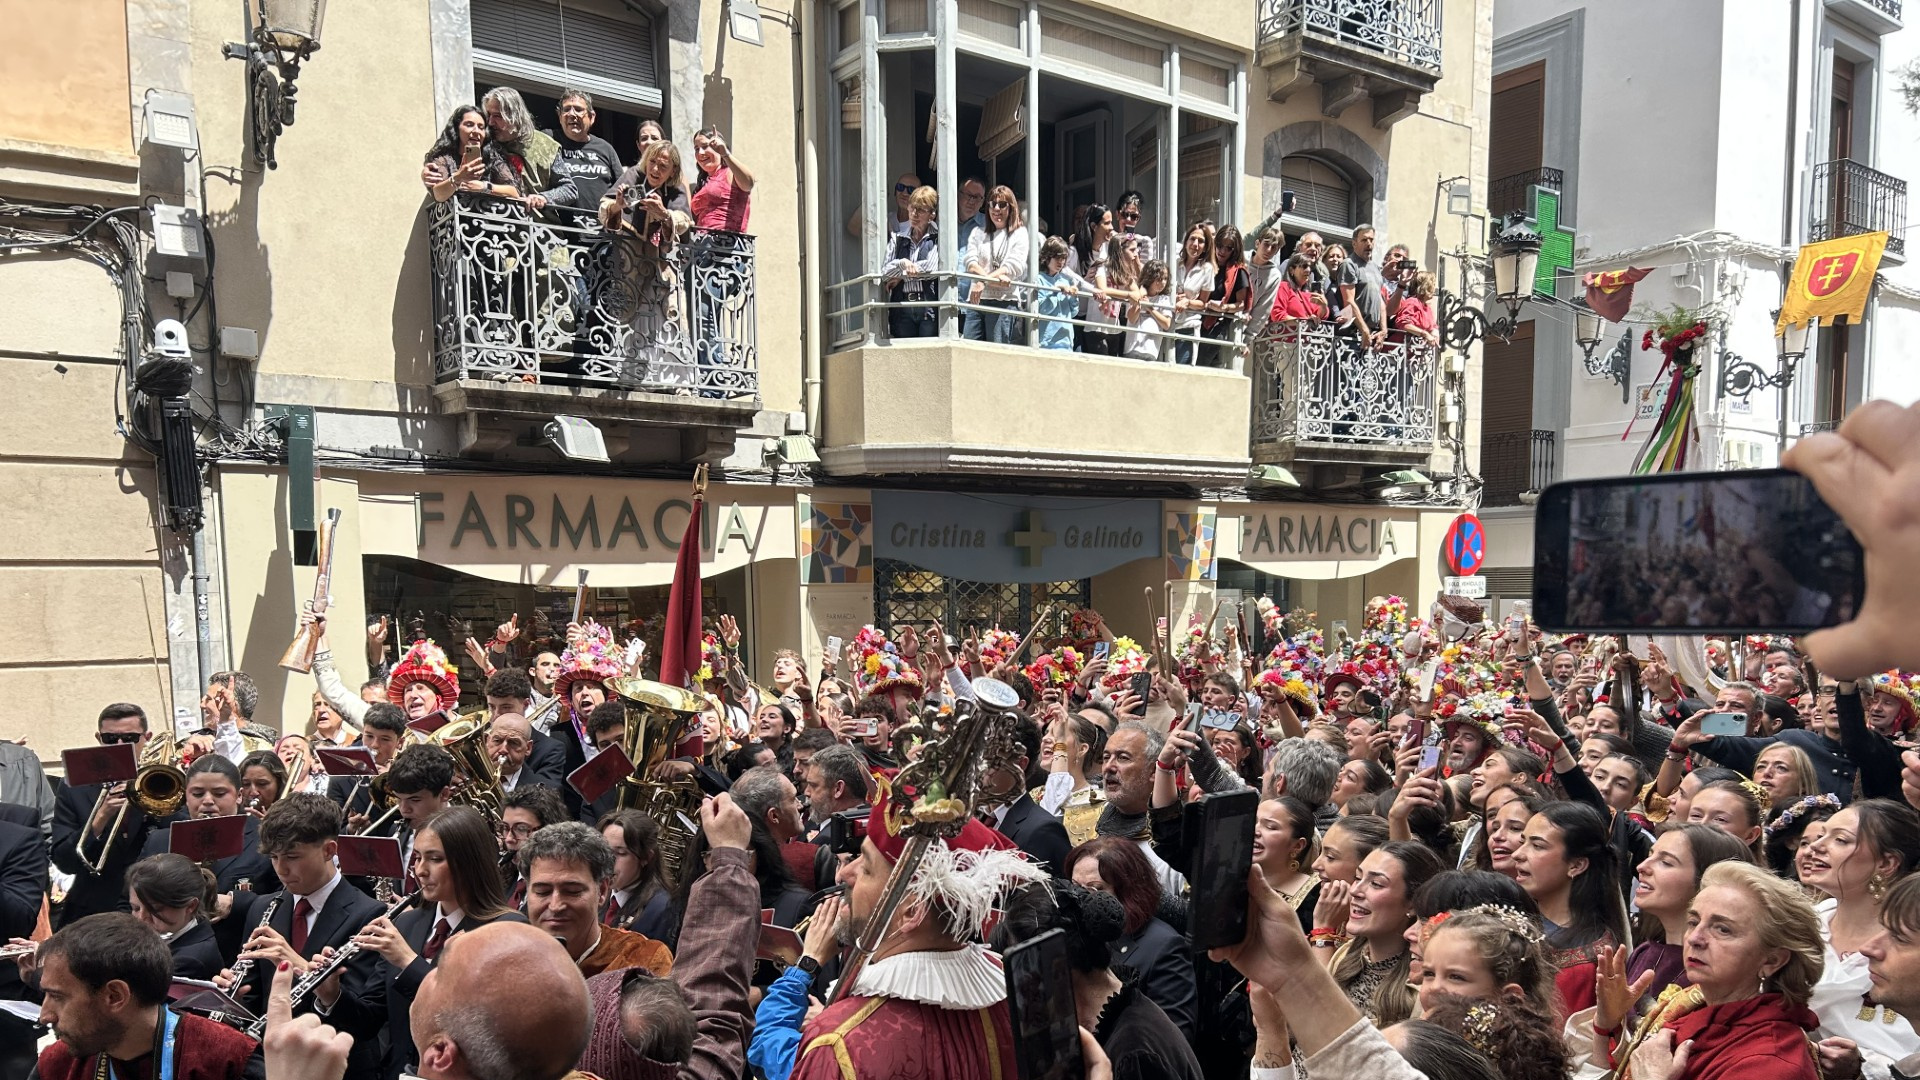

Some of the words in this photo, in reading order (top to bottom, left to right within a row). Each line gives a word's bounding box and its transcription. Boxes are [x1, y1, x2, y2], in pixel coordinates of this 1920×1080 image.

[564, 162, 608, 174] RGENTE
[415, 489, 754, 553] FARMACIA
[890, 522, 986, 548] Cristina
[1064, 524, 1144, 549] Galindo
[1238, 514, 1398, 554] FARMACIA
